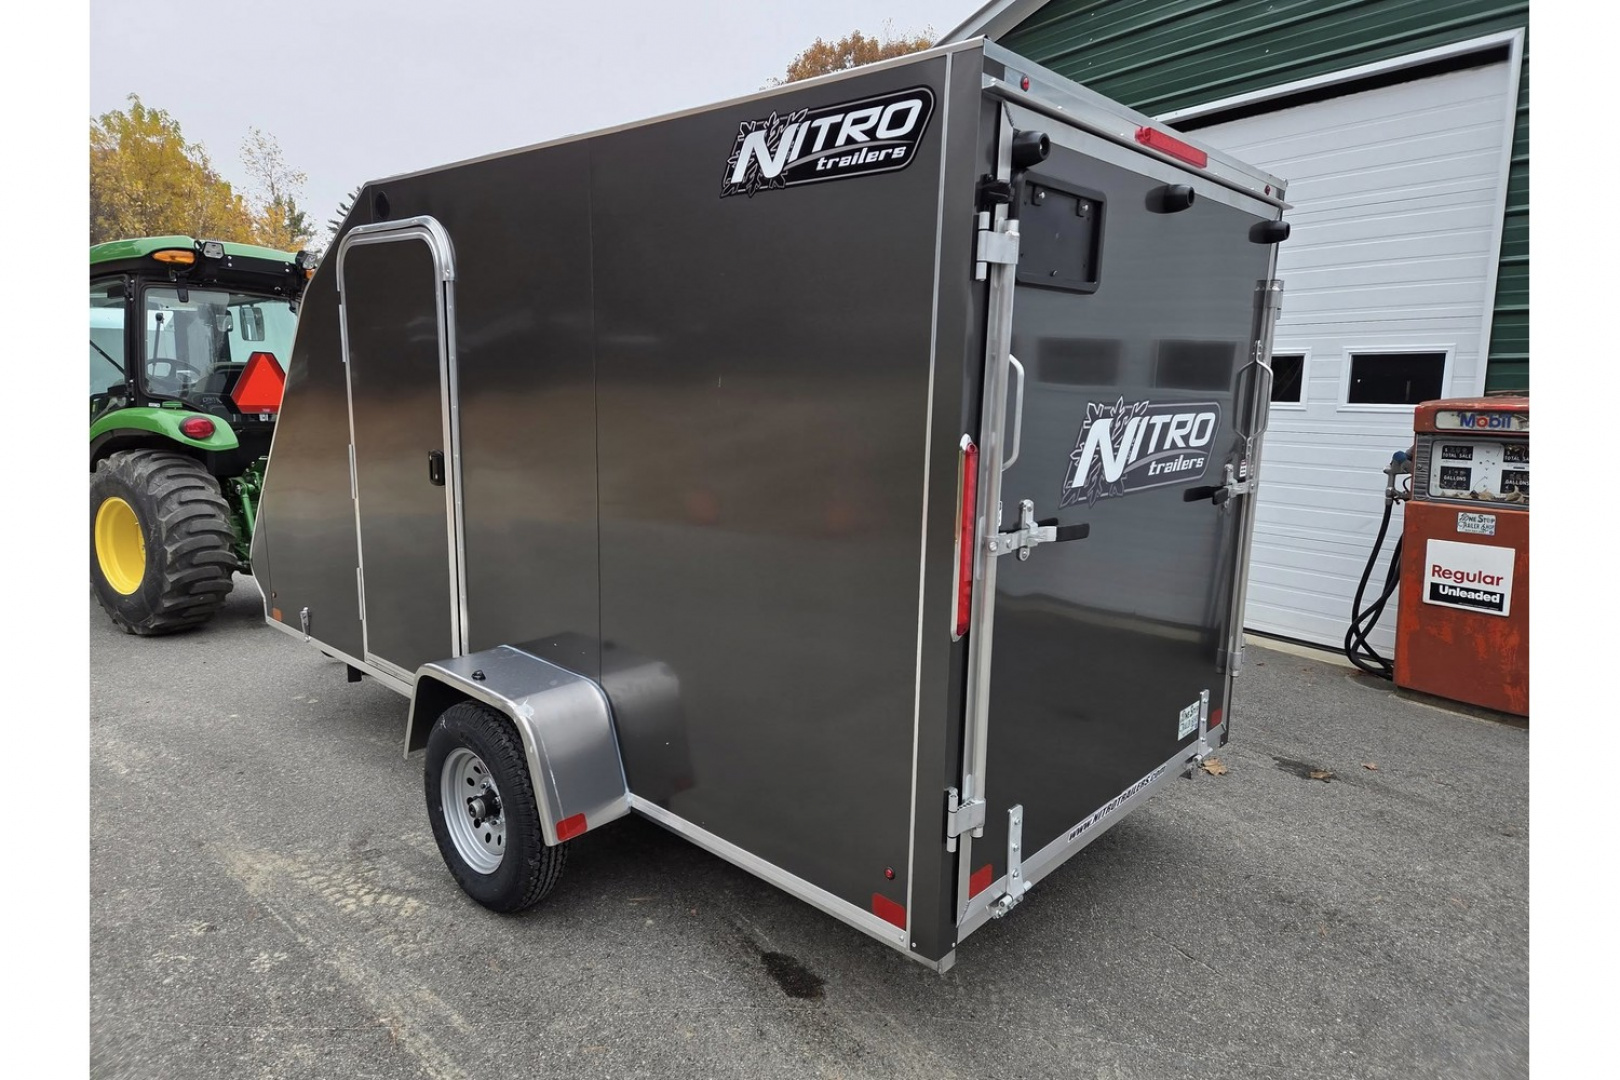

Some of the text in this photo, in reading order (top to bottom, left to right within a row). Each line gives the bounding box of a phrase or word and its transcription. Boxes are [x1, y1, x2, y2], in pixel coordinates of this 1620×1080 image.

[730, 98, 923, 184] NITRO
[815, 146, 907, 171] trailers
[1460, 413, 1511, 428] Mobil
[1072, 412, 1216, 488] NITRO
[1148, 454, 1204, 476] trailers
[1431, 564, 1504, 586] Regular
[1439, 584, 1500, 604] Unleaded
